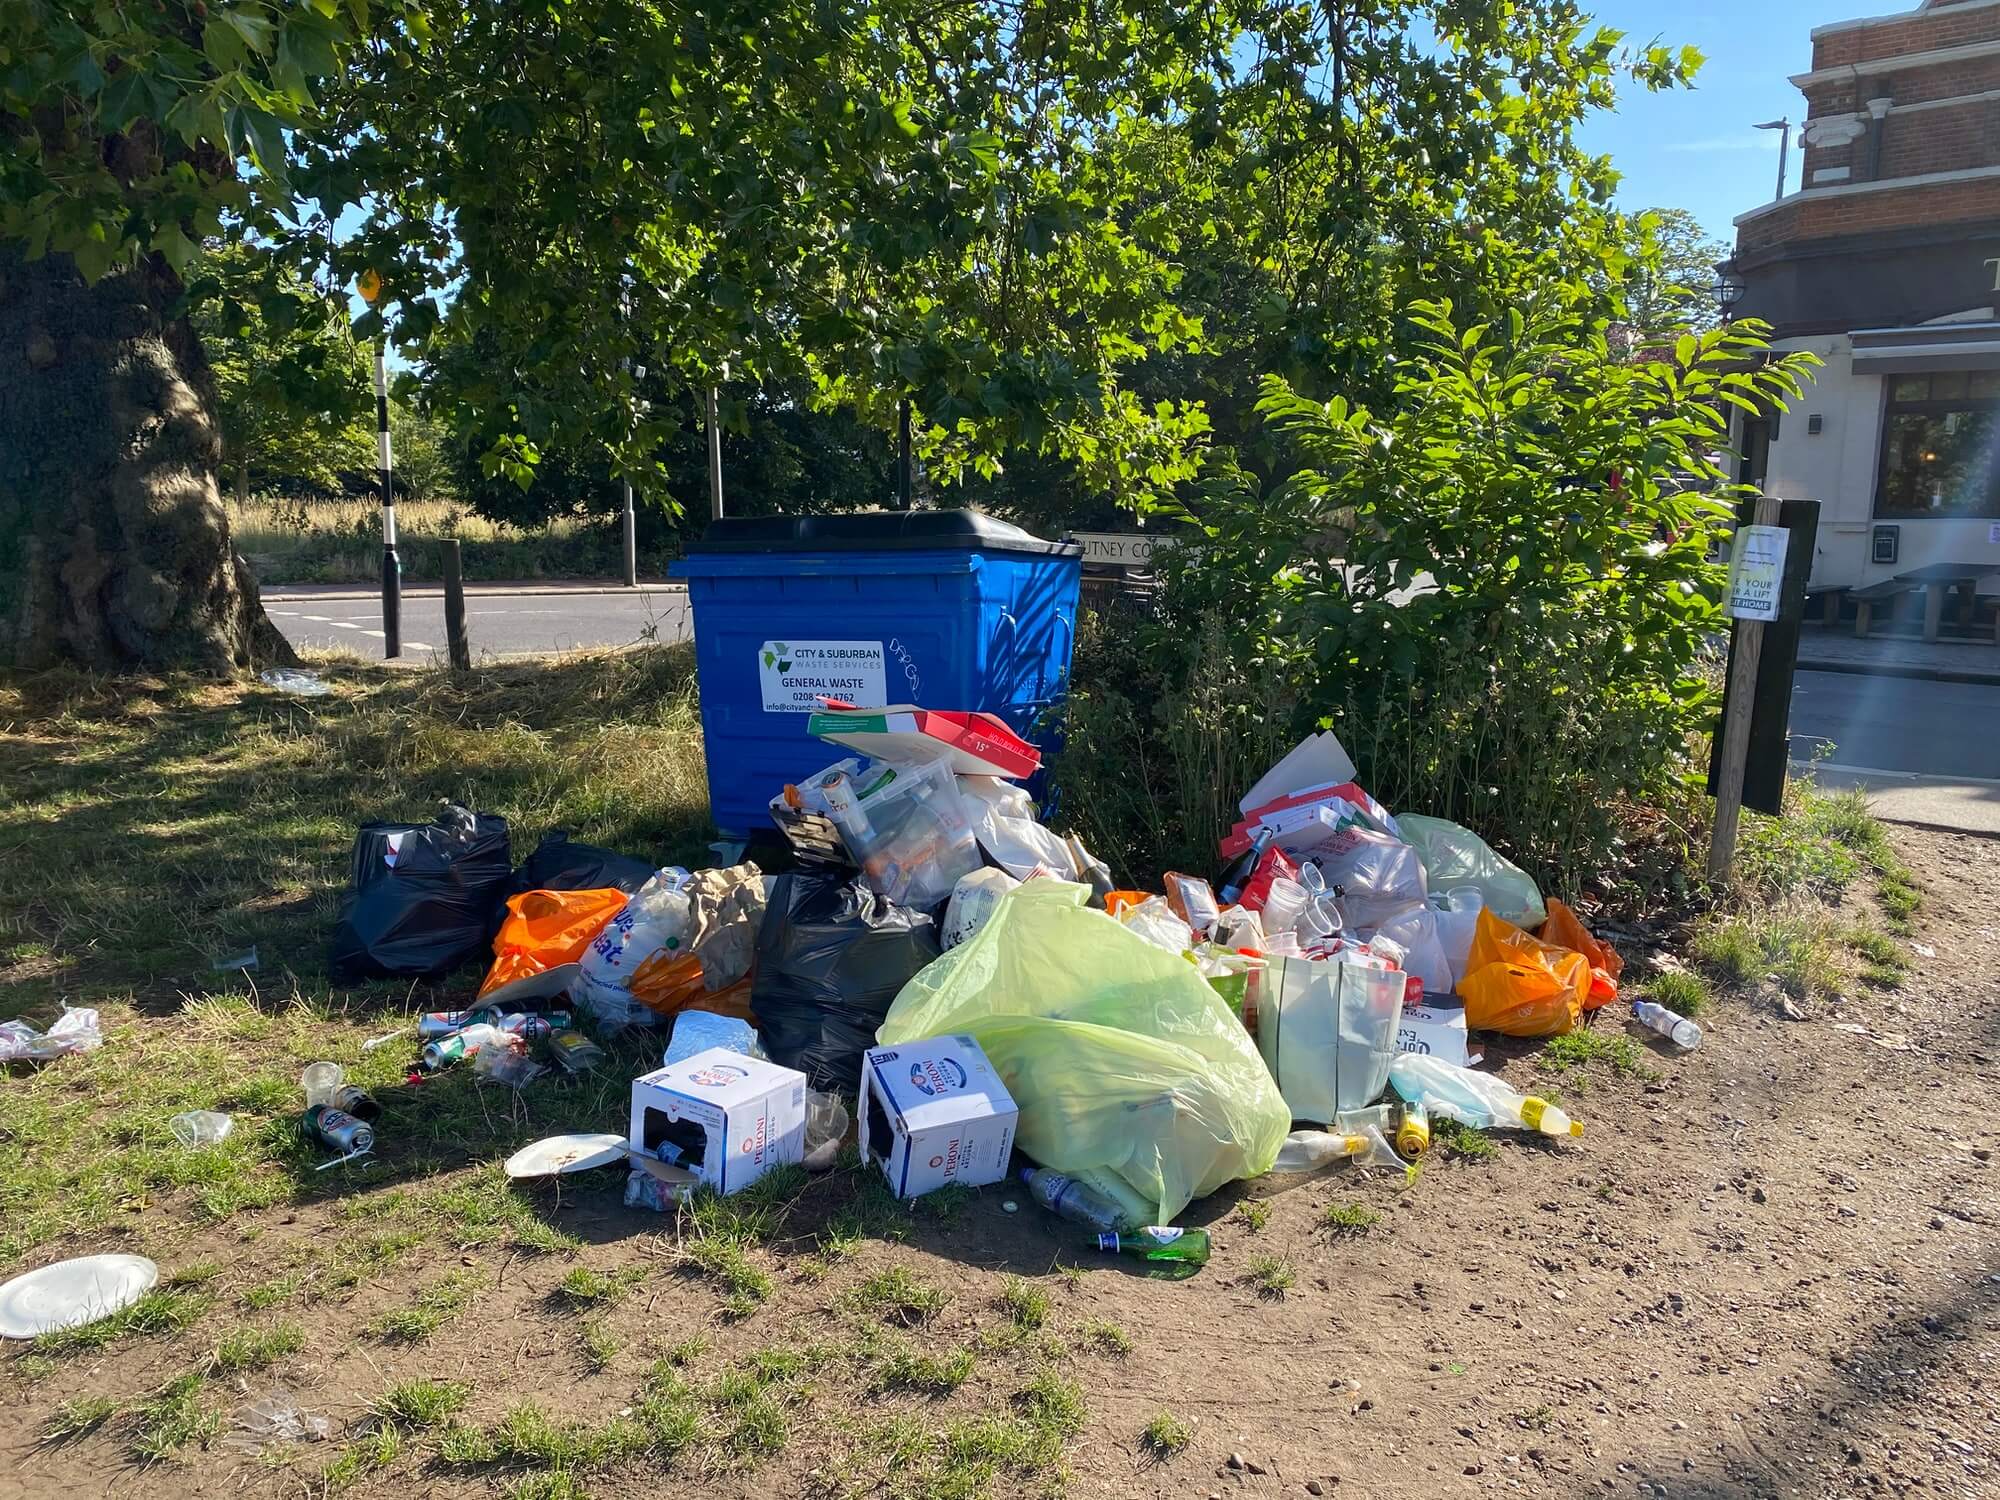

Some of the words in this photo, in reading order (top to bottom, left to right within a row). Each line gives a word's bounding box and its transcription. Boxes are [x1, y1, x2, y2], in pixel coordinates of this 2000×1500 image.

[1984, 257, 2000, 291] T
[1746, 579, 1772, 589] YOUR
[1754, 590, 1771, 598] LIFT
[1742, 600, 1769, 609] HOME
[794, 649, 816, 658] CITY
[818, 649, 826, 658] &
[827, 649, 880, 659] SUBURBAN
[795, 661, 829, 669] WASTE
[833, 661, 881, 670] SERVICES
[782, 677, 827, 688] GENERAL
[829, 677, 864, 689] WASTE
[792, 692, 814, 701] 0208
[833, 693, 855, 702] 4762
[922, 1059, 949, 1094] PERONI
[754, 1116, 765, 1165] PERONI
[944, 1138, 960, 1178] PERONI
